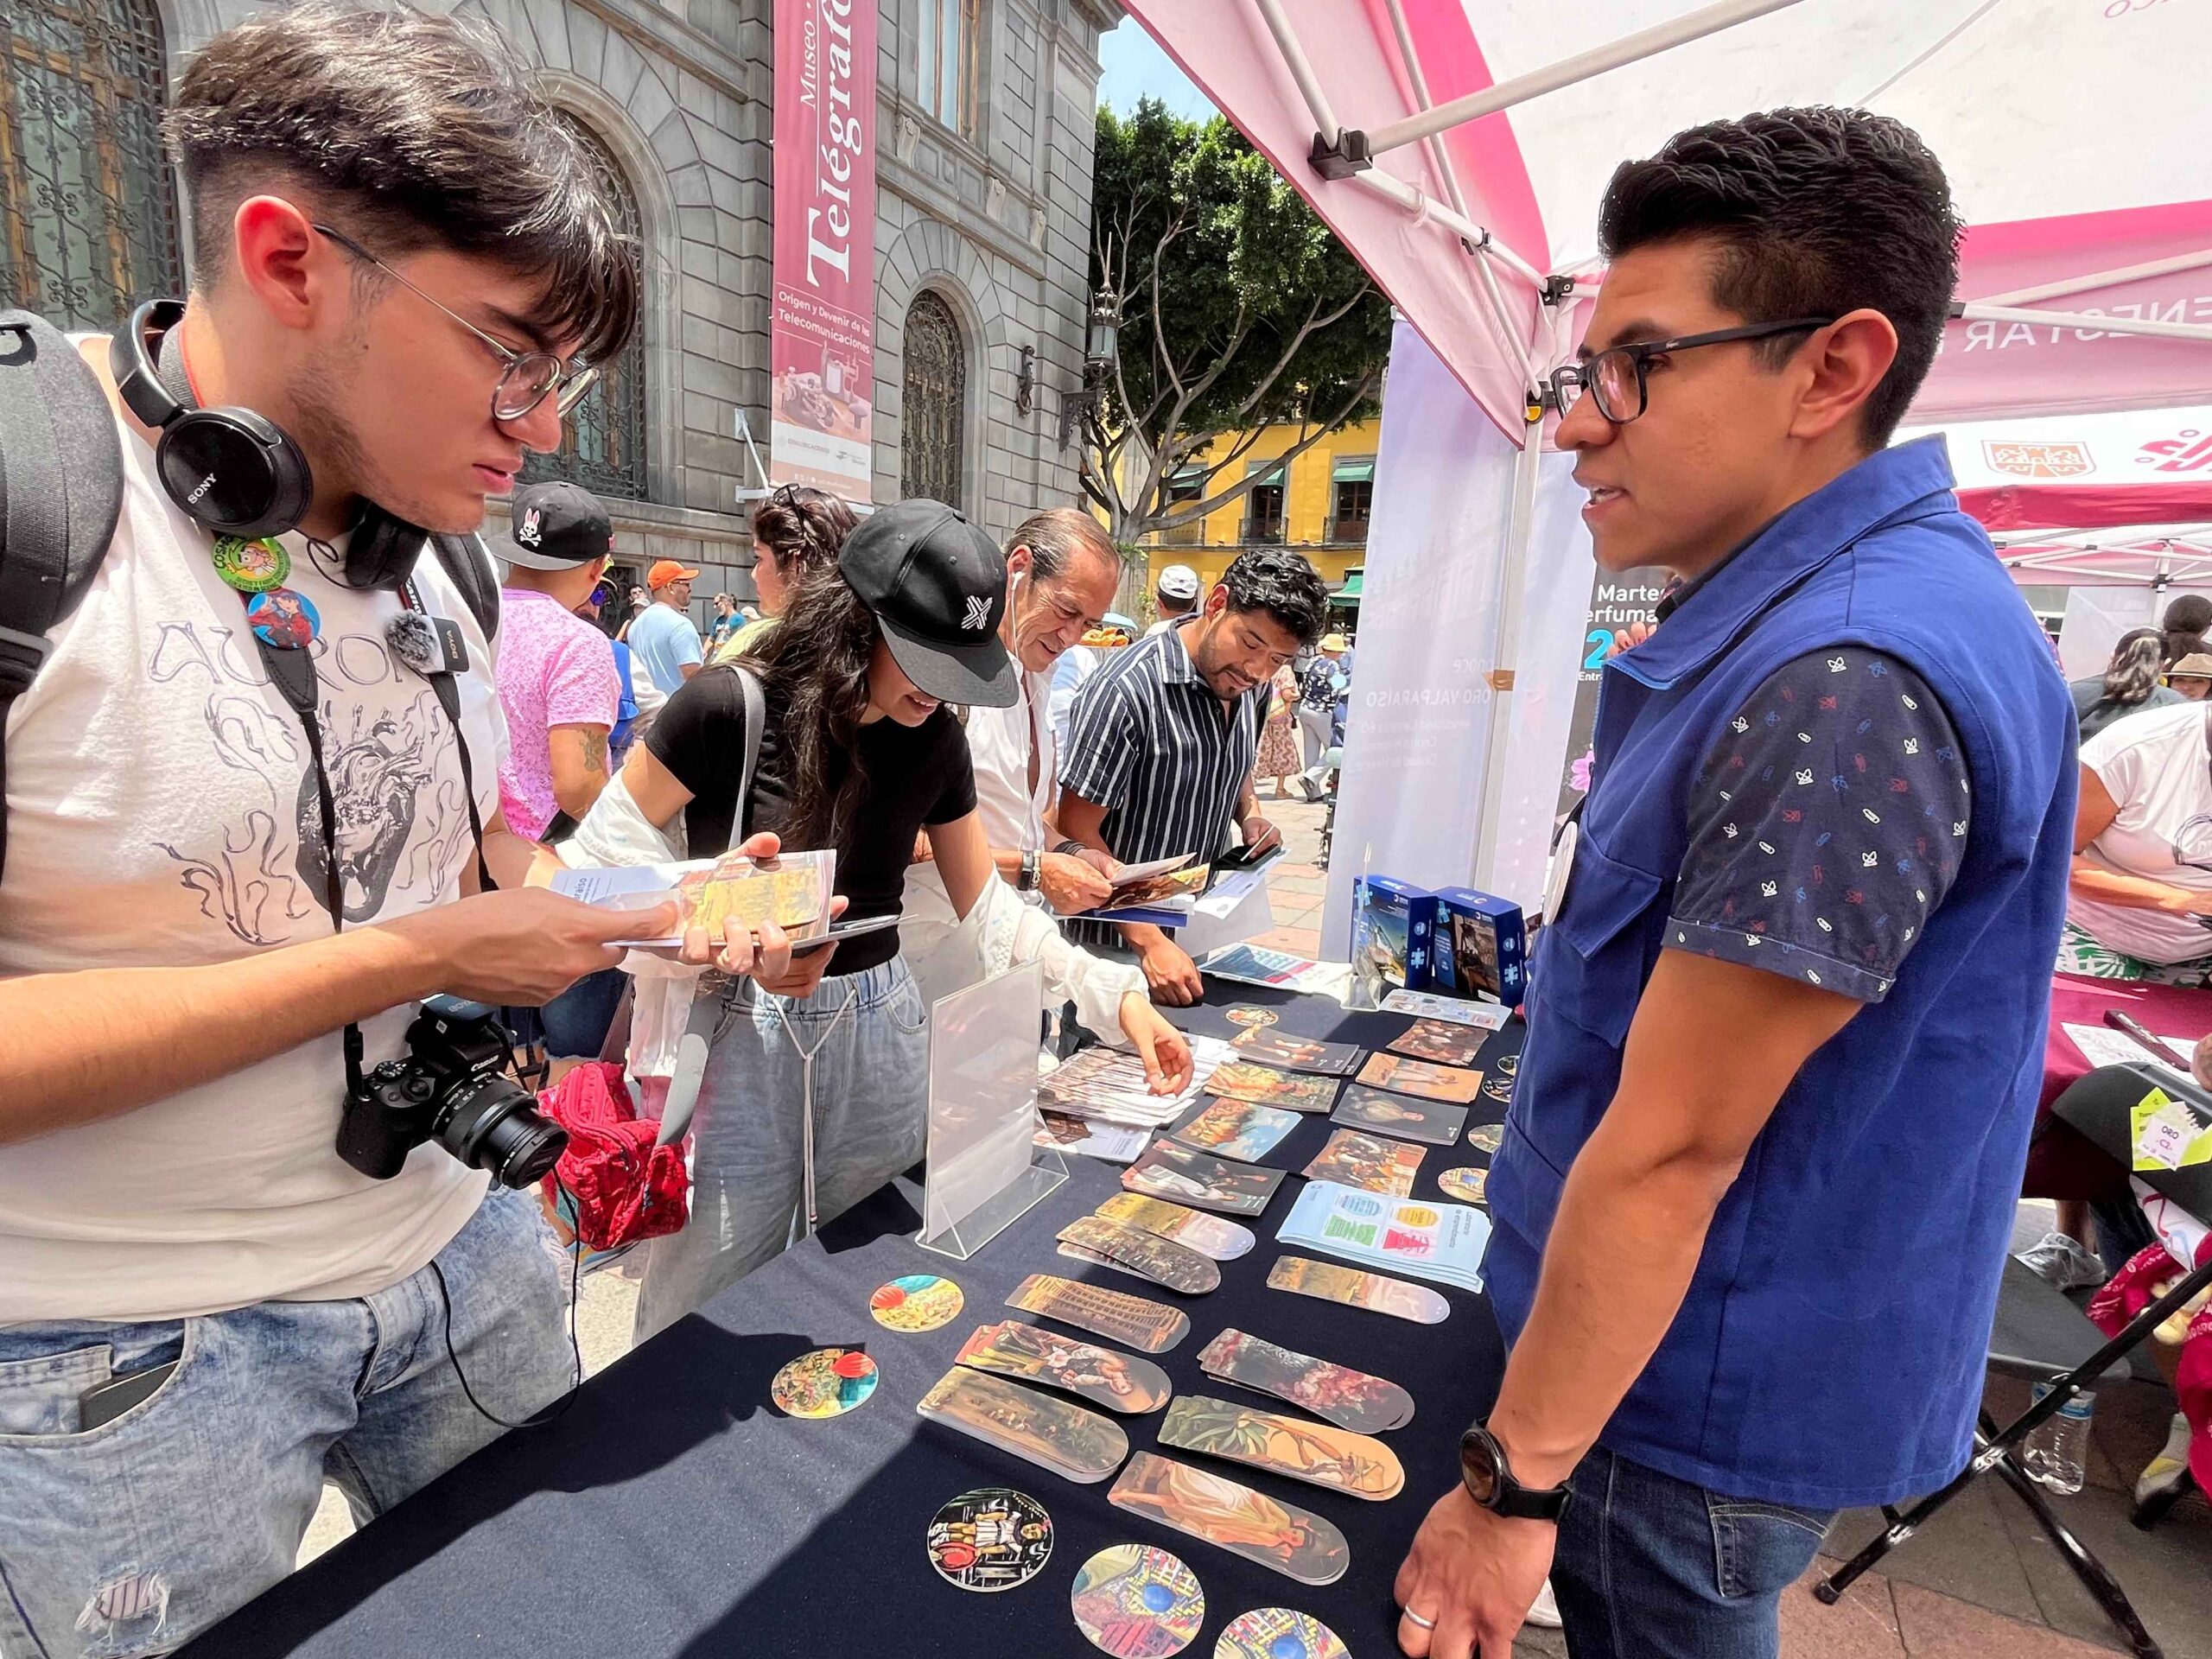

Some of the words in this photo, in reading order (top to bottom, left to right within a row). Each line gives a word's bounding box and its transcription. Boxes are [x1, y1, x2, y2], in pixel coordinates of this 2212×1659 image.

[800, 21, 817, 111] Museo
[778, 290, 811, 312] Origen
[811, 303, 818, 316] y
[818, 308, 850, 328] Devenir
[851, 317, 861, 331] de
[861, 322, 870, 338] las
[778, 308, 871, 355] Telecomunicaciones
[188, 473, 218, 505] SONY
[446, 630, 459, 659] BOYA
